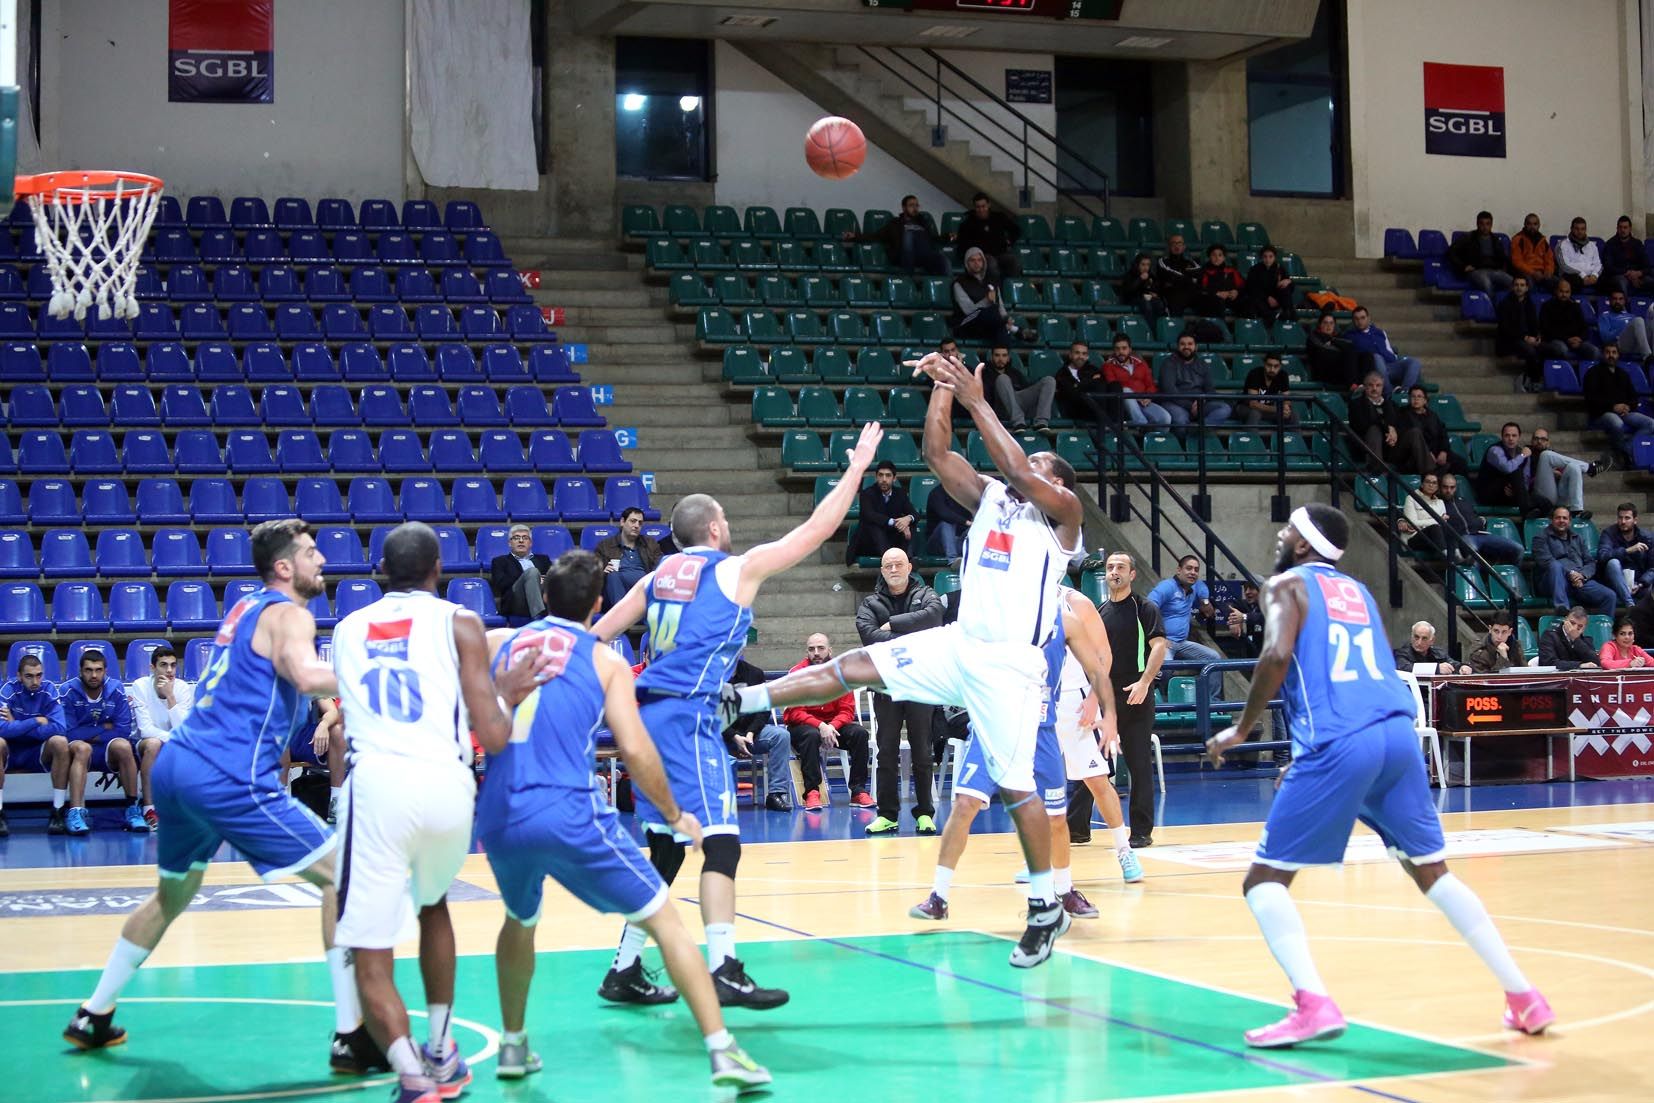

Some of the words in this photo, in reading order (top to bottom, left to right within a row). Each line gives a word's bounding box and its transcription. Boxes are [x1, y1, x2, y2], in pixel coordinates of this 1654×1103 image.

[174, 58, 268, 77] SGBL
[1429, 116, 1502, 135] SGBL
[519, 273, 532, 288] K
[545, 309, 555, 325] J
[592, 388, 604, 403] H
[615, 430, 629, 447] G
[647, 602, 683, 660] 14
[890, 647, 913, 669] 44
[1328, 622, 1385, 683] 21
[360, 667, 424, 723] 10
[1466, 696, 1502, 711] POSS.
[960, 762, 979, 785] 7
